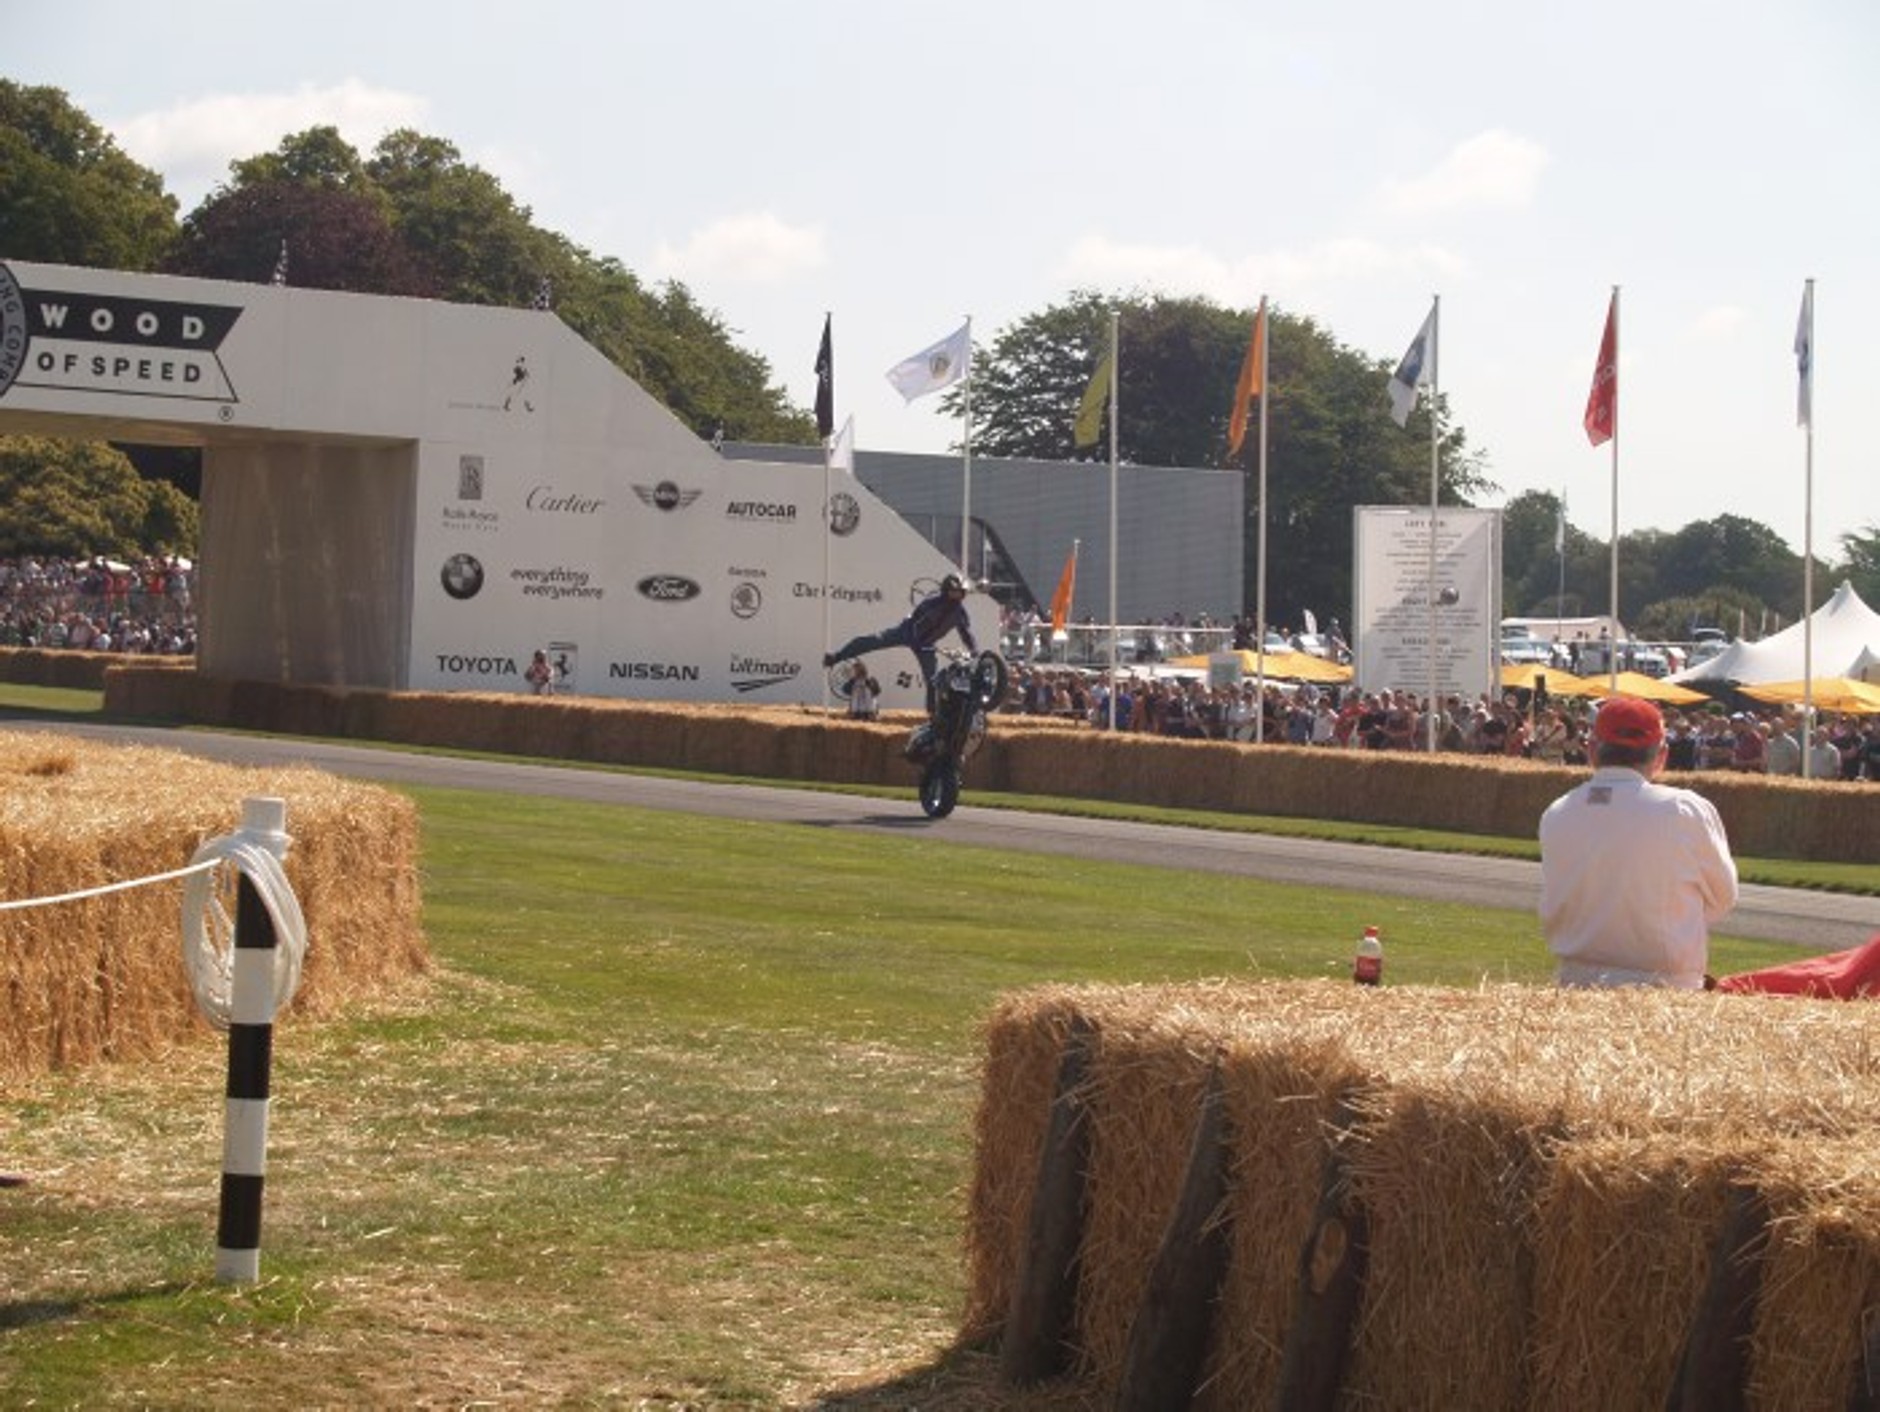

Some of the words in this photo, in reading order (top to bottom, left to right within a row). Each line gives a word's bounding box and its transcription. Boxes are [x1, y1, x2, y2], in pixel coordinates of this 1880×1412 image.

[40, 303, 205, 340] WOOD
[37, 352, 77, 373] OF
[91, 356, 201, 383] SPEED
[526, 485, 605, 514] Cartier
[727, 502, 797, 519] AUTOCAR
[509, 566, 590, 587] everything
[523, 585, 603, 600] everywhere
[436, 655, 517, 675] TOYOTA
[609, 662, 700, 681] NISSAN
